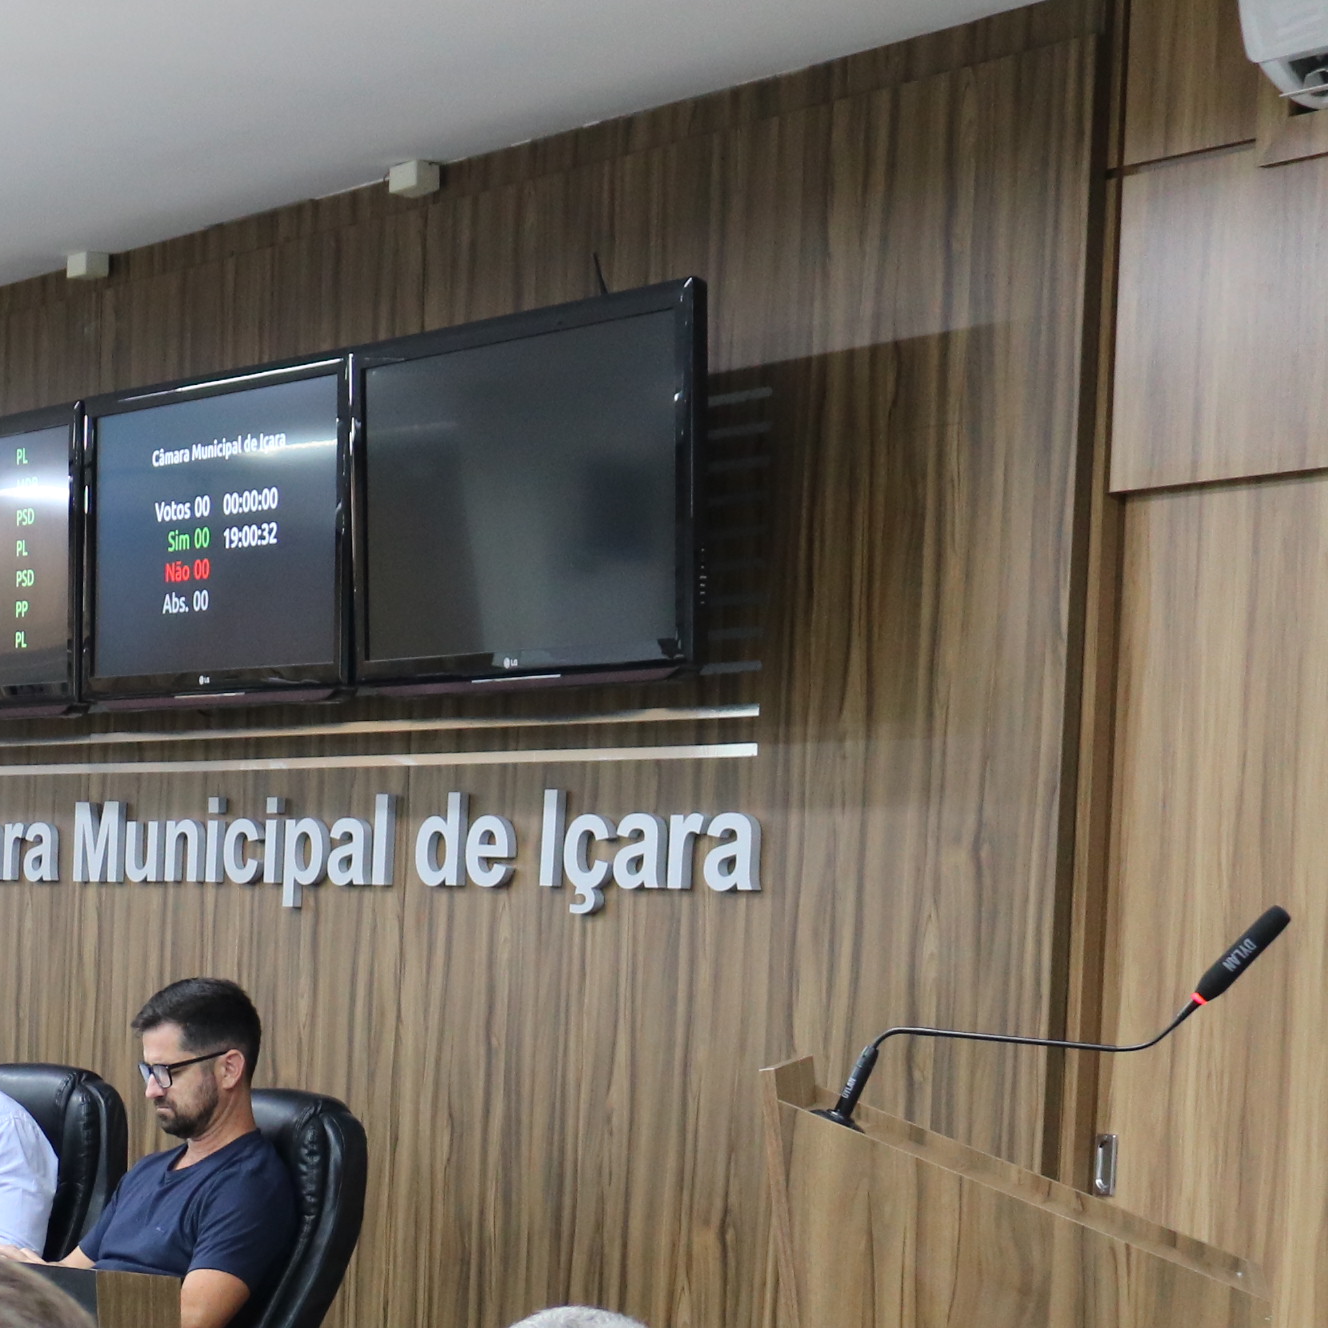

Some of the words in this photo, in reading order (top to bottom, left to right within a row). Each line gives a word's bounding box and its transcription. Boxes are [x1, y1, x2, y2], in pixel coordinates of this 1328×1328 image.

[16, 448, 28, 465] PL
[152, 448, 190, 467] Câmara
[191, 435, 242, 461] Municipal
[244, 433, 257, 453] de
[259, 433, 286, 454] Içara
[154, 501, 191, 523] Votos
[194, 495, 211, 518] 00
[223, 486, 278, 515] 00:00:00
[16, 507, 35, 527] PSD
[167, 530, 190, 552] Sim
[195, 526, 210, 549] 00
[223, 522, 278, 549] 19:00:32
[16, 540, 28, 557] PL
[16, 569, 35, 588] PSD
[165, 561, 190, 583] Não
[194, 558, 210, 580] 00
[15, 600, 29, 618] PP
[162, 592, 189, 614] Abs.
[193, 589, 209, 612] 00
[15, 631, 27, 648] PL
[72, 793, 397, 909] Municipal
[415, 791, 517, 889] de
[539, 788, 762, 915] Içara
[1222, 937, 1257, 972] DYLAN
